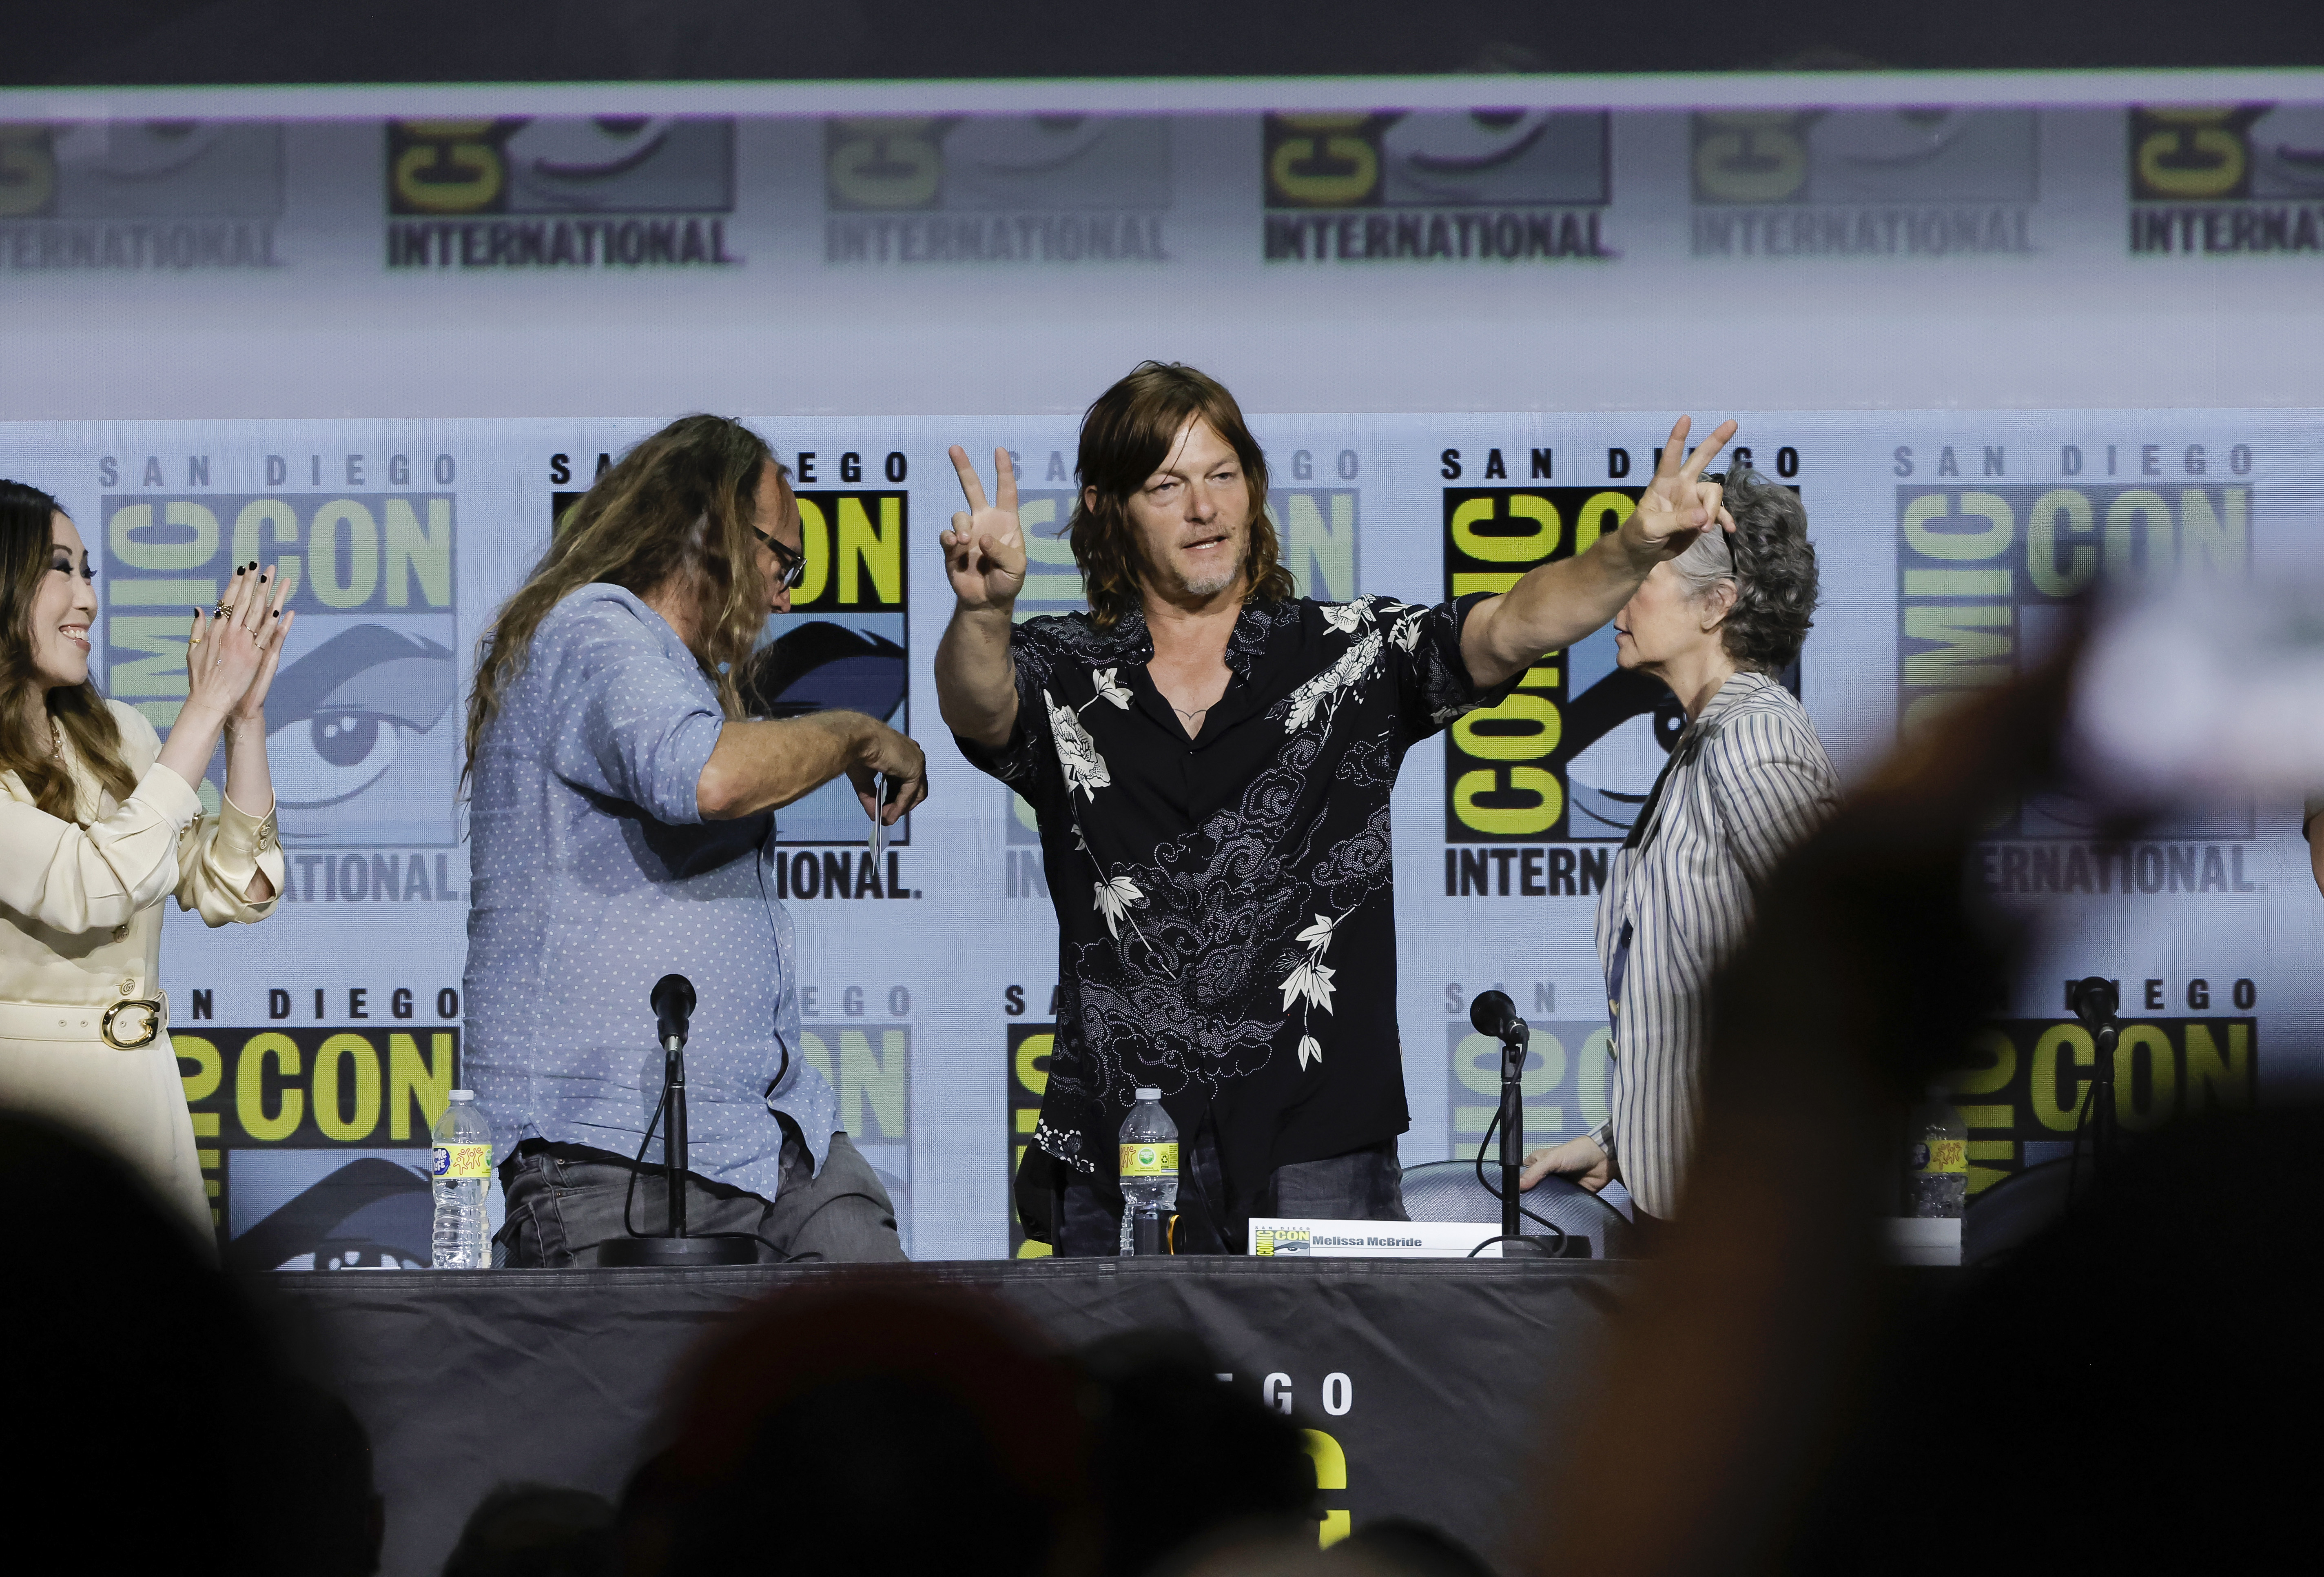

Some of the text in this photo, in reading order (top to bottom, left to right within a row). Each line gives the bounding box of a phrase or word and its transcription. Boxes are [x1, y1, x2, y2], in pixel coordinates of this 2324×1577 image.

[100, 454, 455, 486] SAN DIEGO
[798, 452, 908, 483] EGO
[1441, 448, 1552, 479] SAN
[1894, 444, 2252, 477] SAN DIEGO
[232, 499, 451, 608] CON
[2027, 490, 2247, 597] CON
[270, 988, 459, 1019] DIEGO
[801, 985, 910, 1016] EGO
[1444, 982, 1555, 1013] SN
[236, 1032, 453, 1140] CON
[2031, 1023, 2249, 1131] CON
[1256, 1230, 1274, 1256] COMIC
[1275, 1231, 1309, 1241] CON
[1312, 1236, 1422, 1247] Melissa McBride
